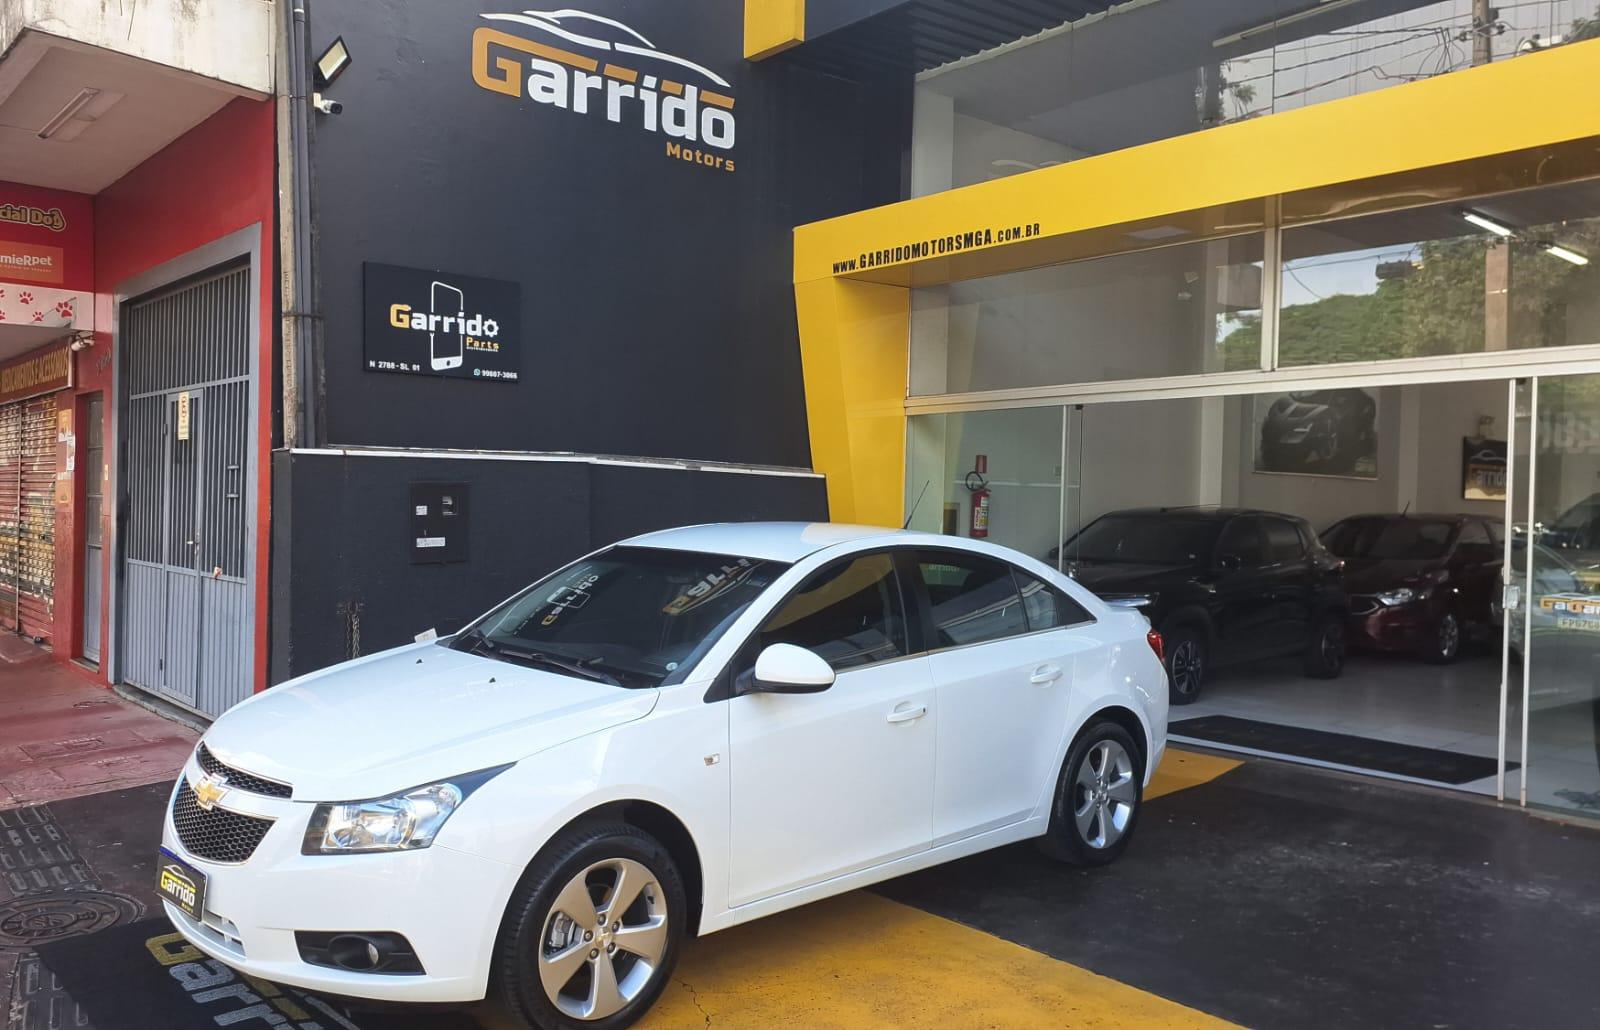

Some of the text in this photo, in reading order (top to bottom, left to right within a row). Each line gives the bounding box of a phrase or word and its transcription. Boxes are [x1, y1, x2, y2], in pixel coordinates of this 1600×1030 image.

[472, 27, 735, 149] Garrido
[666, 142, 735, 172] Motors
[390, 304, 499, 337] Garrido
[466, 337, 499, 349] Parts
[160, 870, 197, 907] Garrido
